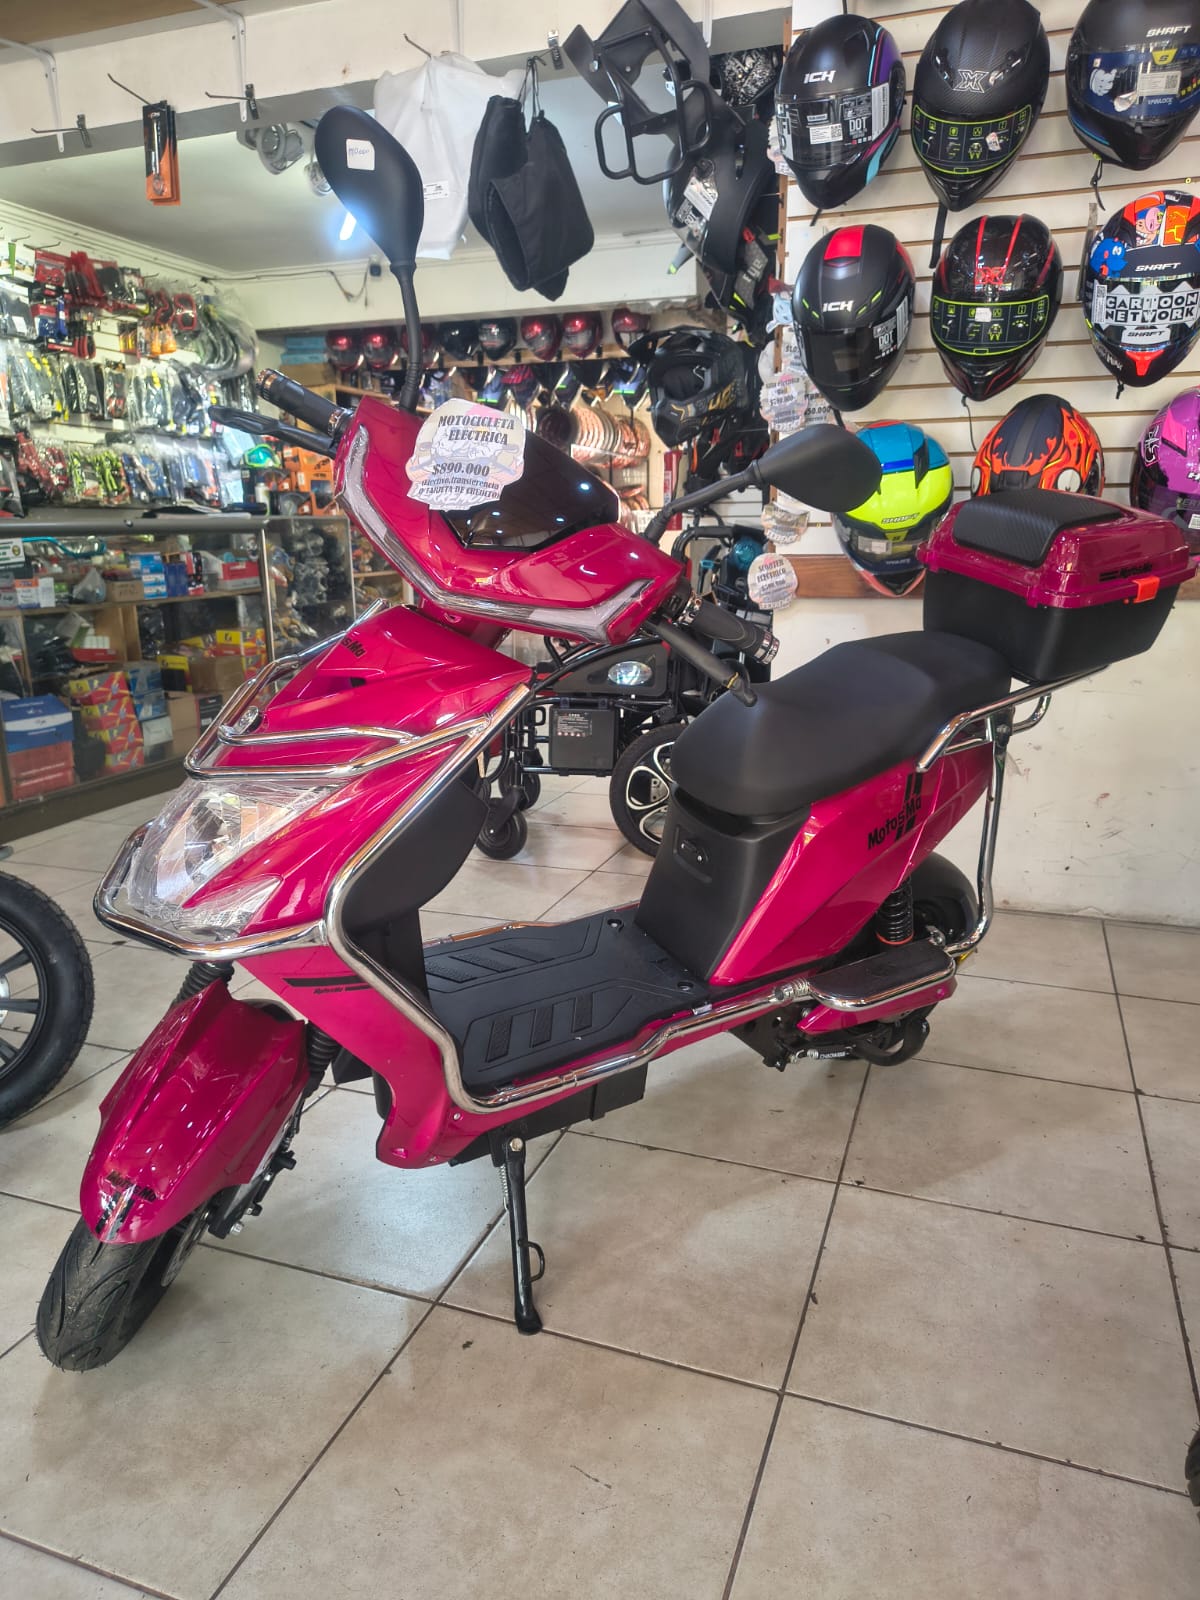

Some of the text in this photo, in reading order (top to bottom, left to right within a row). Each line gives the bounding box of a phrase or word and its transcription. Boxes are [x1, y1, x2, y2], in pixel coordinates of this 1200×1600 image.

[1146, 25, 1192, 38] SHAFT
[803, 70, 836, 84] ICH
[849, 117, 867, 132] DOT
[1135, 262, 1182, 272] SHAFT
[822, 300, 854, 312] ICH
[1105, 306, 1196, 324] NETWORK
[438, 415, 514, 430] MOTOCICLETA
[448, 429, 508, 445] ELECTRICA
[432, 462, 490, 477] $890.000
